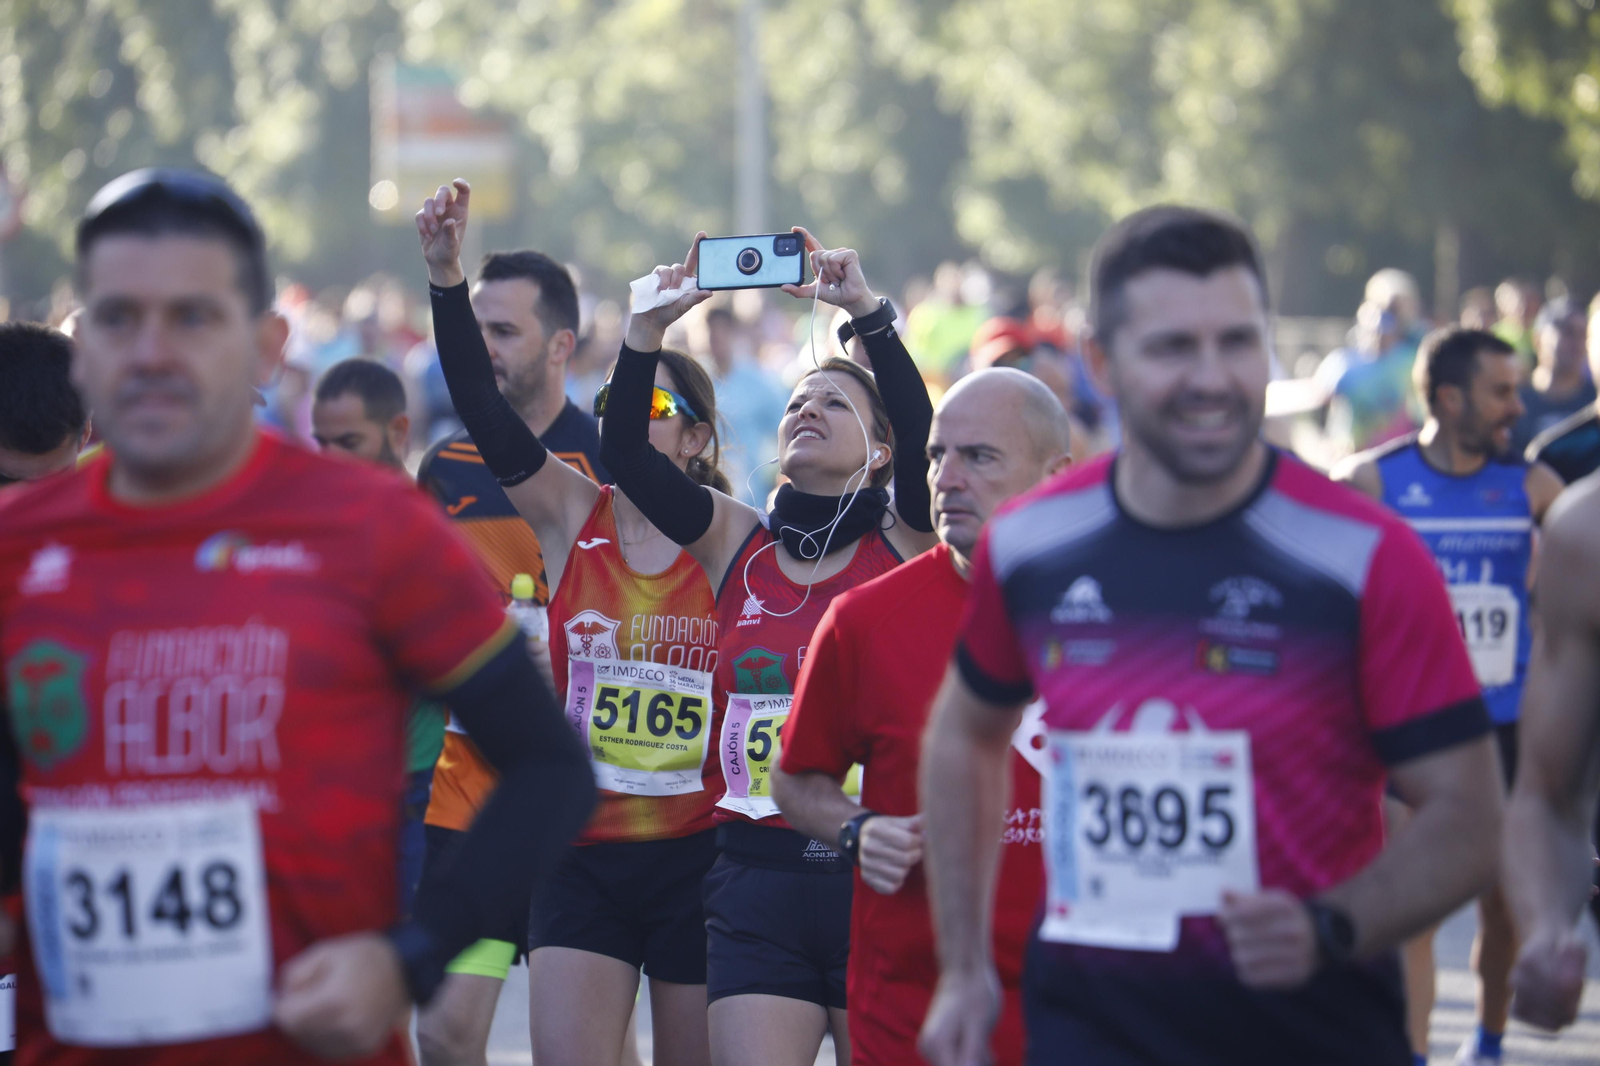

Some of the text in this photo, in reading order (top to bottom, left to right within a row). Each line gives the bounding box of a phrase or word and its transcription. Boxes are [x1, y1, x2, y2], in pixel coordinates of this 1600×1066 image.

[630, 613, 719, 647] FUNDACIÓN
[612, 665, 665, 681] IMDECO
[592, 686, 703, 740] 5165
[599, 735, 688, 751] ESTHER RODRÍGUEZ COSTA
[727, 732, 740, 775] CAJÓN
[1083, 780, 1235, 849] 3695
[65, 859, 244, 941] 3148
